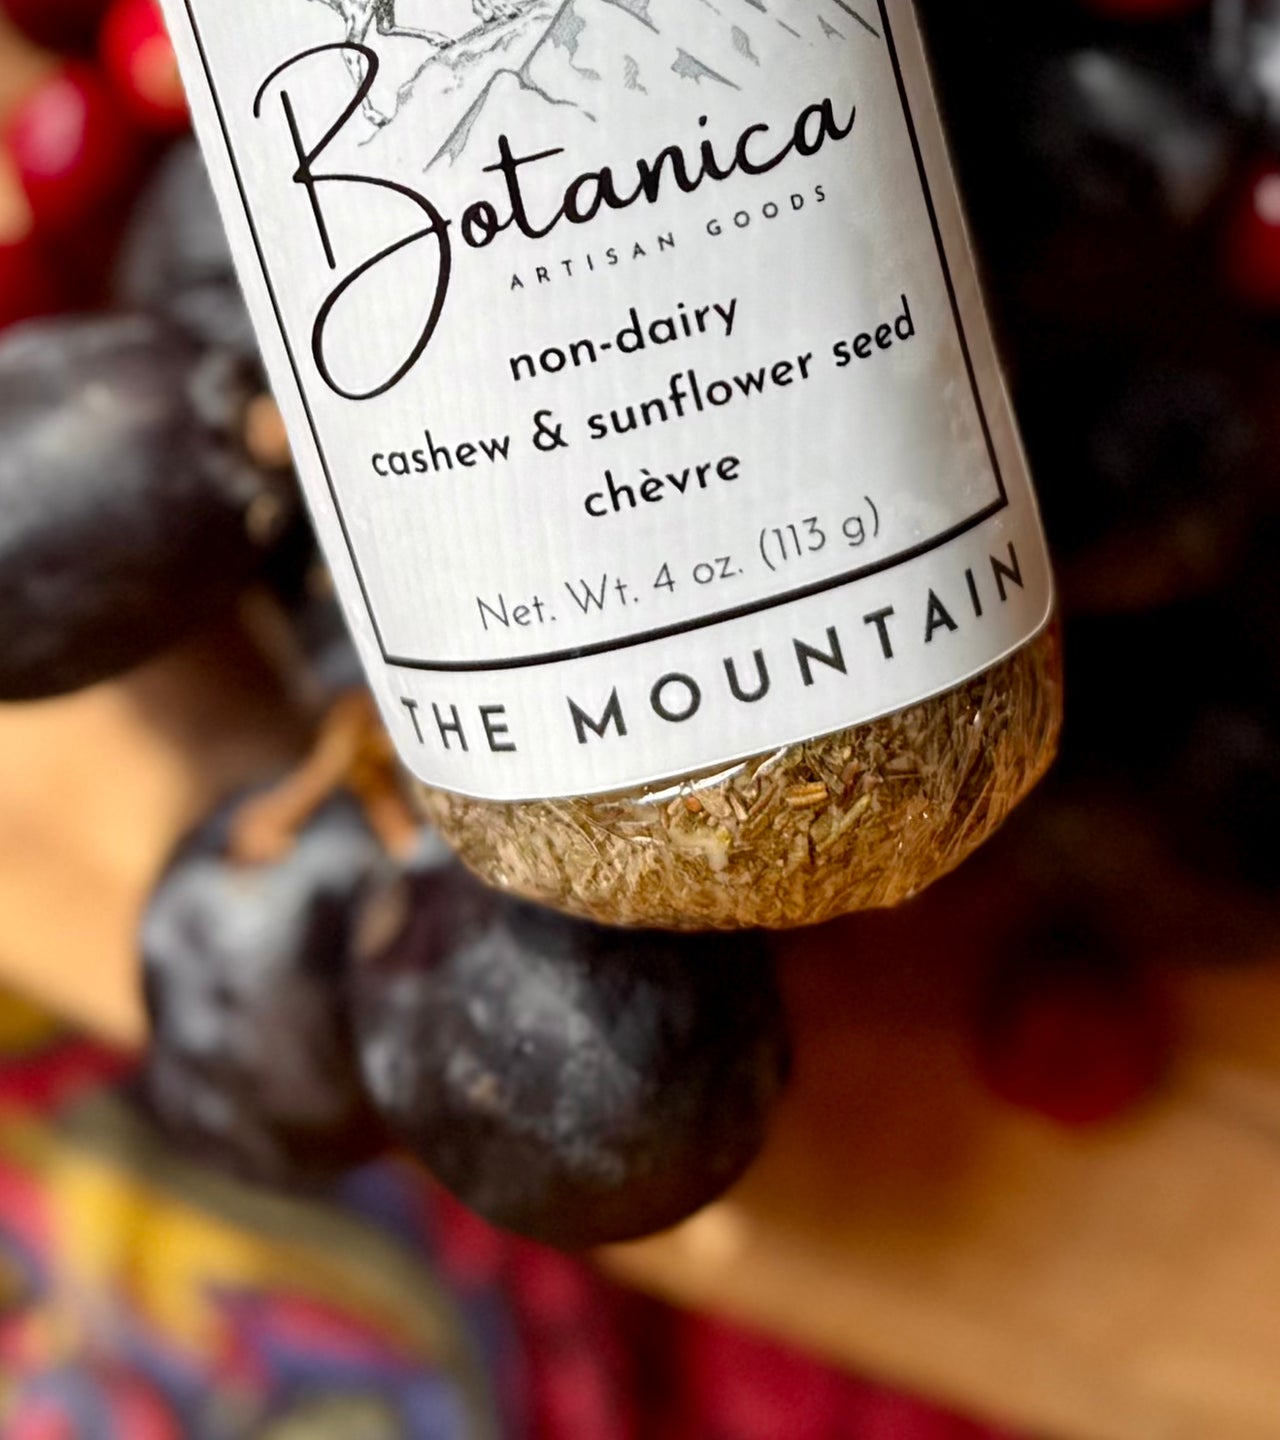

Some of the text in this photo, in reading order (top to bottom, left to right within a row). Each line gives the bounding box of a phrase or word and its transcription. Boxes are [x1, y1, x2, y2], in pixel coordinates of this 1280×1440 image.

[252, 41, 857, 402] Botanica
[509, 184, 827, 291] ARTISAN GOODS
[370, 294, 916, 478] cashew & sunflower seed
[509, 297, 738, 382] non-dairy
[583, 452, 741, 518] chèvre
[475, 495, 881, 633] Net. Wt. 4 oz. (113 g)
[400, 541, 1025, 754] THE MOUNTAIN
